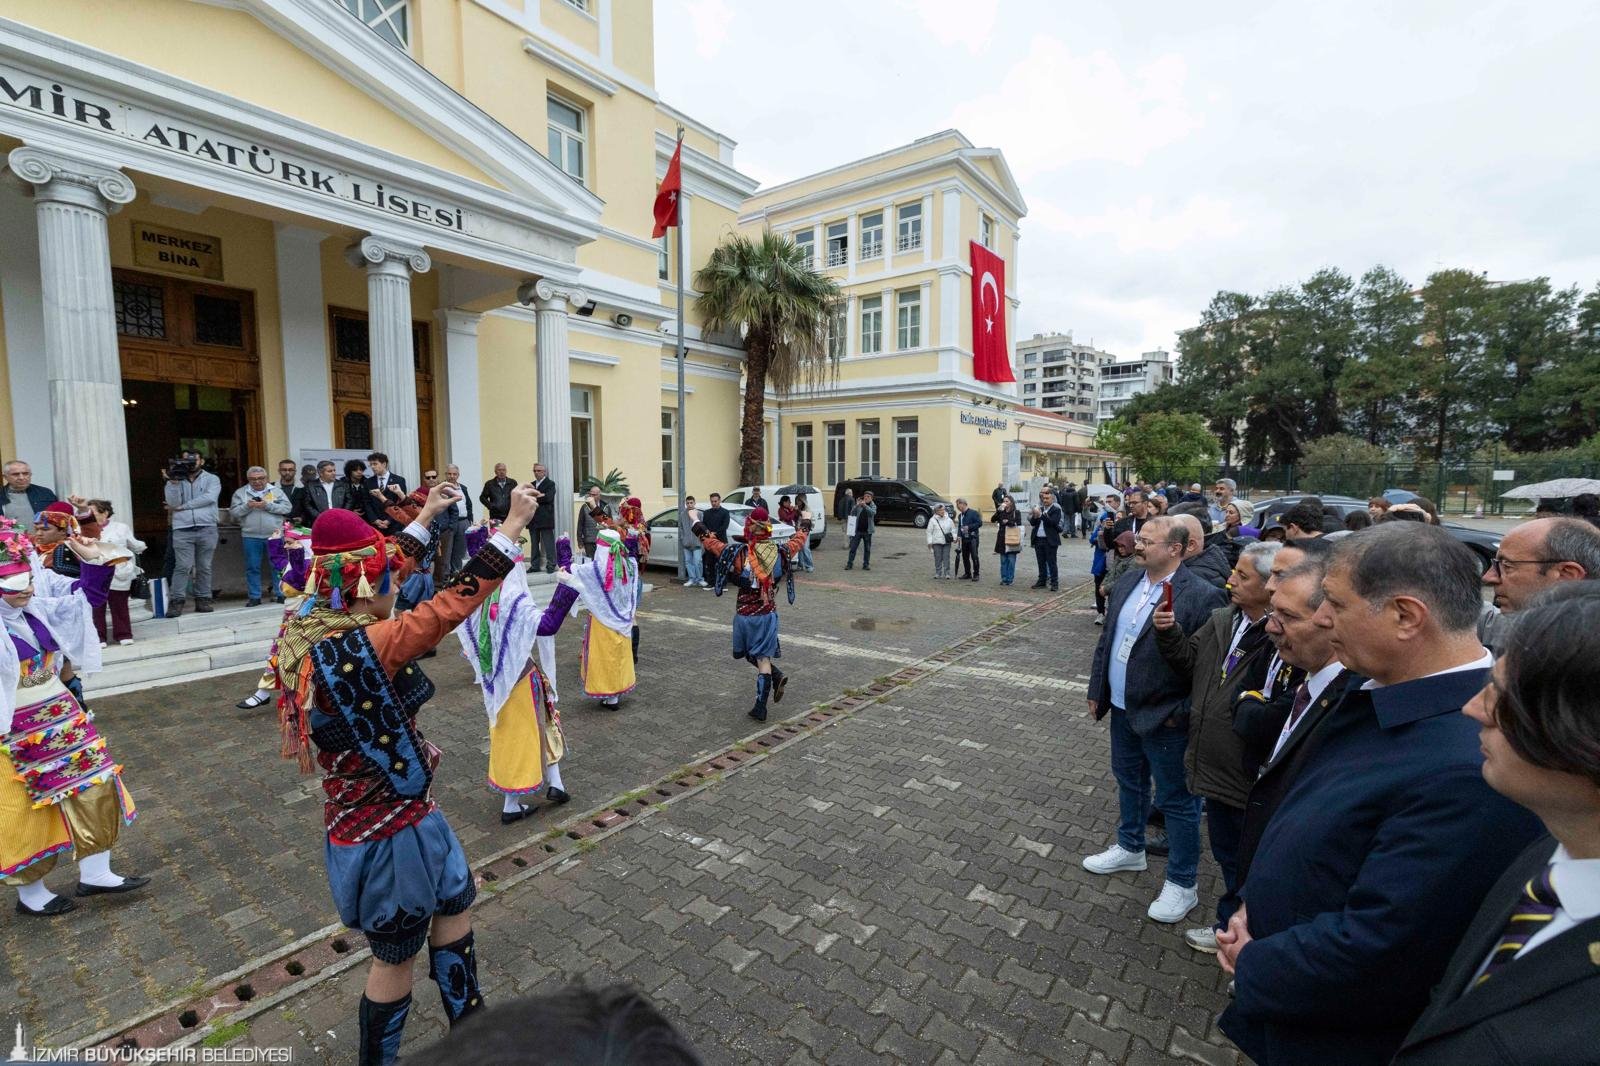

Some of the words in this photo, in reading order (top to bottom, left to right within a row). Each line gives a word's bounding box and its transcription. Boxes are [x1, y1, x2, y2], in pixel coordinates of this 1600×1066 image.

[142, 123, 337, 195] ATATÜRK
[352, 182, 463, 231] LİSESİ
[141, 230, 214, 255] MERKEZ
[157, 250, 201, 269] BİNA
